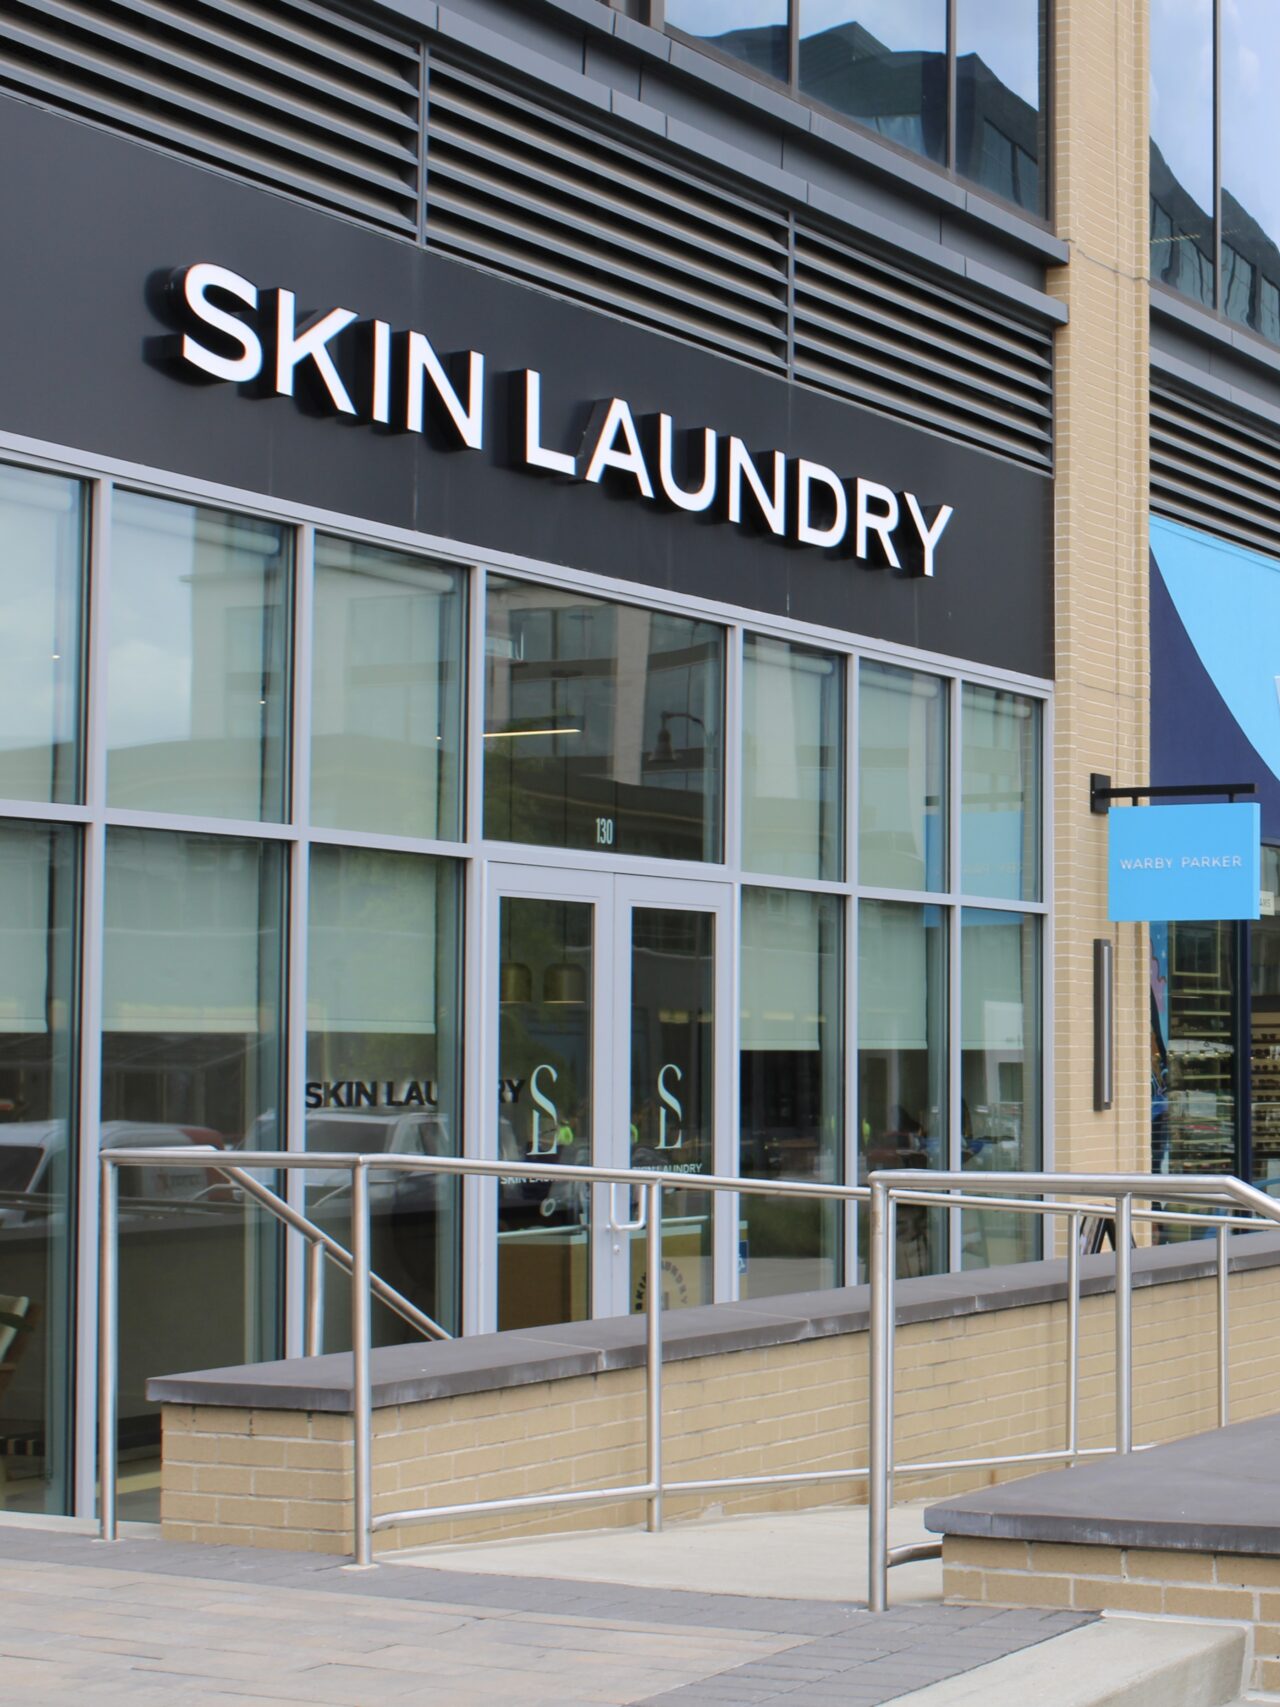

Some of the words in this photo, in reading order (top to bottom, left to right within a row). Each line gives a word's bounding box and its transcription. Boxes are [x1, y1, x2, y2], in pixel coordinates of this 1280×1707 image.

[182, 262, 486, 450] SKIN
[525, 368, 954, 578] LAUNDRY
[595, 817, 614, 845] 130
[1119, 856, 1174, 871] WARBY
[1180, 854, 1243, 870] PARKER
[305, 1079, 379, 1109] SKIN
